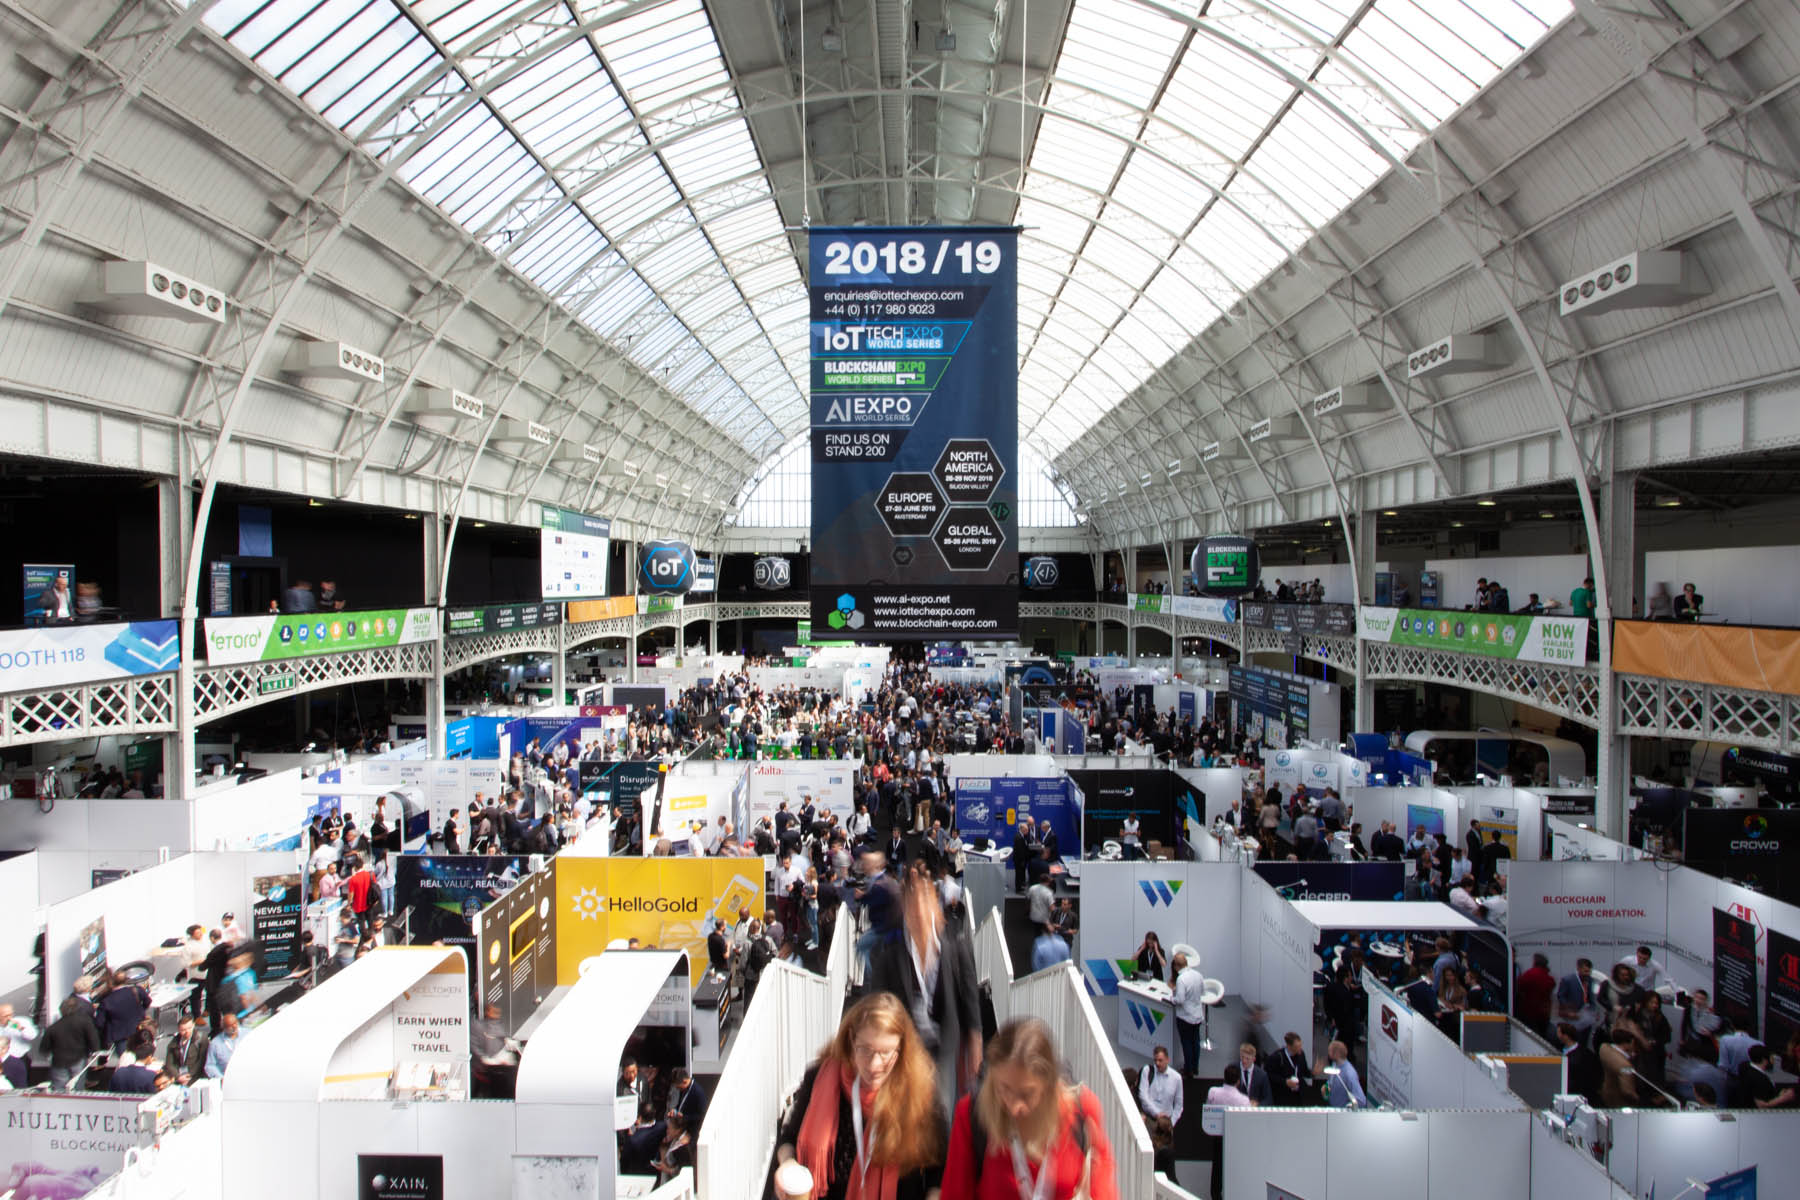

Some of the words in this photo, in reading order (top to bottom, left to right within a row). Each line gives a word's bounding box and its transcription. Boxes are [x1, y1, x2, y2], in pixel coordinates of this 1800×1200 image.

[824, 240, 1001, 275] 2018/19
[824, 290, 964, 302] enquiries@iottechexpo.com
[824, 305, 844, 315] +44
[847, 304, 861, 317] (0)
[864, 305, 882, 315] 117
[885, 305, 906, 315] 980
[908, 305, 935, 315] 9023
[824, 327, 865, 351] IoT
[868, 339, 904, 349] WORLD
[906, 339, 941, 349] SERIES
[828, 375, 861, 384] WORLD
[862, 375, 893, 384] SERIES
[854, 414, 883, 422] WORLD
[885, 414, 910, 422] SERIES
[825, 435, 851, 445] FIND
[854, 435, 870, 445] US
[872, 435, 890, 445] ON
[825, 446, 863, 456] STAND
[866, 446, 886, 456] 200
[950, 452, 988, 461] NORTH
[944, 463, 994, 473] AMERICA
[888, 493, 933, 503] EUROPE
[948, 526, 992, 536] GLOBAL
[1207, 553, 1248, 567] EXPO
[652, 559, 682, 576] IoT
[874, 595, 951, 605] www.ai-expo.net
[874, 607, 975, 618] www.iottechexpo.com
[413, 612, 431, 624] NOW
[874, 620, 998, 630] www.blockchain-expo.com
[1542, 623, 1575, 640] NOW
[61, 647, 85, 663] 118
[1543, 648, 1554, 658] TO
[1557, 648, 1575, 660] BUY
[1730, 840, 1780, 850] CROWD
[420, 880, 442, 888] REAL
[444, 880, 473, 889] VALUE,
[475, 880, 497, 888] REAL
[609, 896, 698, 912] HelloGold
[1543, 896, 1606, 904] BLOCKCHAIN
[254, 905, 282, 916] NEWS
[283, 904, 303, 912] BTC
[1568, 910, 1592, 918] YOUR
[1595, 909, 1646, 918] CREATION.
[268, 919, 296, 928] MILLION
[267, 932, 295, 940] MILLION
[397, 1016, 426, 1025] EARN
[429, 1017, 462, 1026] WHEN
[418, 1030, 441, 1039] YOU
[412, 1044, 452, 1053] TRAVEL
